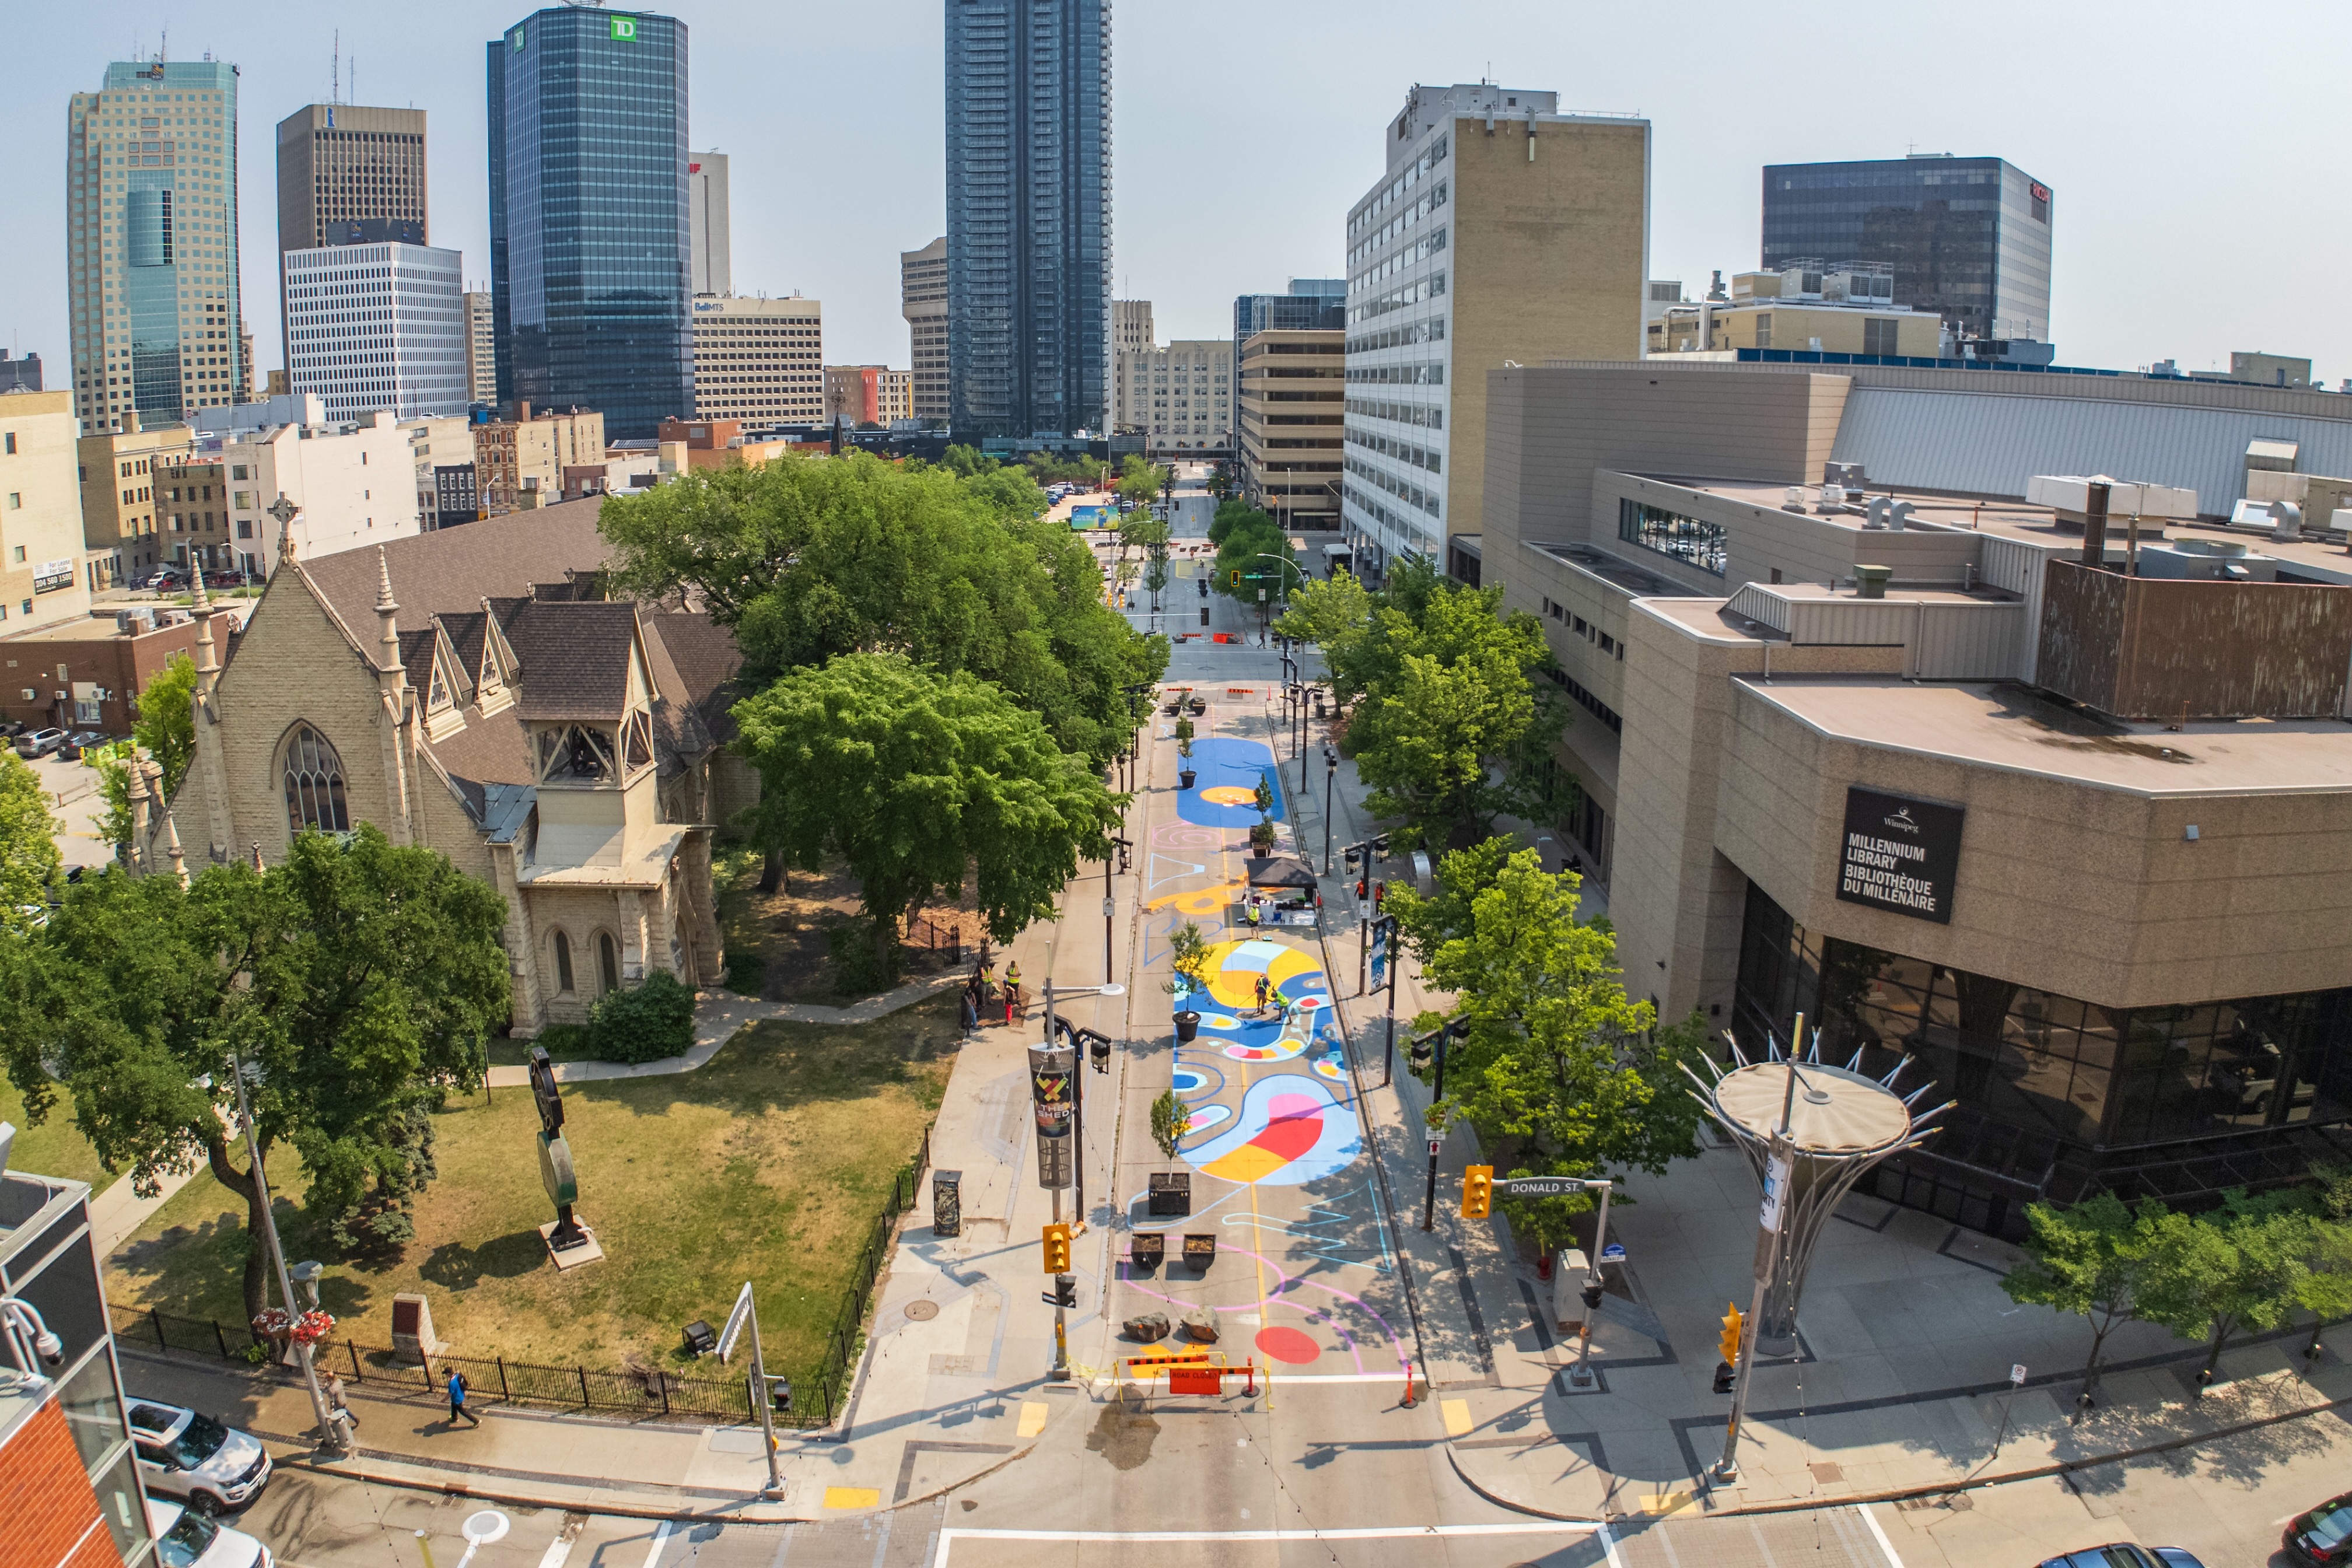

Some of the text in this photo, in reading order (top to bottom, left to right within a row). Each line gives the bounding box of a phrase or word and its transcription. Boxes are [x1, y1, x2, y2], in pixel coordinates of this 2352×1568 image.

[612, 20, 634, 37] TD
[514, 30, 523, 47] TD
[1884, 817, 1919, 834] Winnipeg
[1849, 832, 1925, 862] MILLENNIUM
[1847, 847, 1897, 870] LIBRARY
[1845, 863, 1933, 895] BIBLIOTHÈQUE
[1843, 878, 1936, 912] DU MILLÉNAIRE
[1038, 1110, 1069, 1118] SHED
[1040, 1104, 1065, 1112] THE
[1511, 1182, 1580, 1192] DONALD ST.
